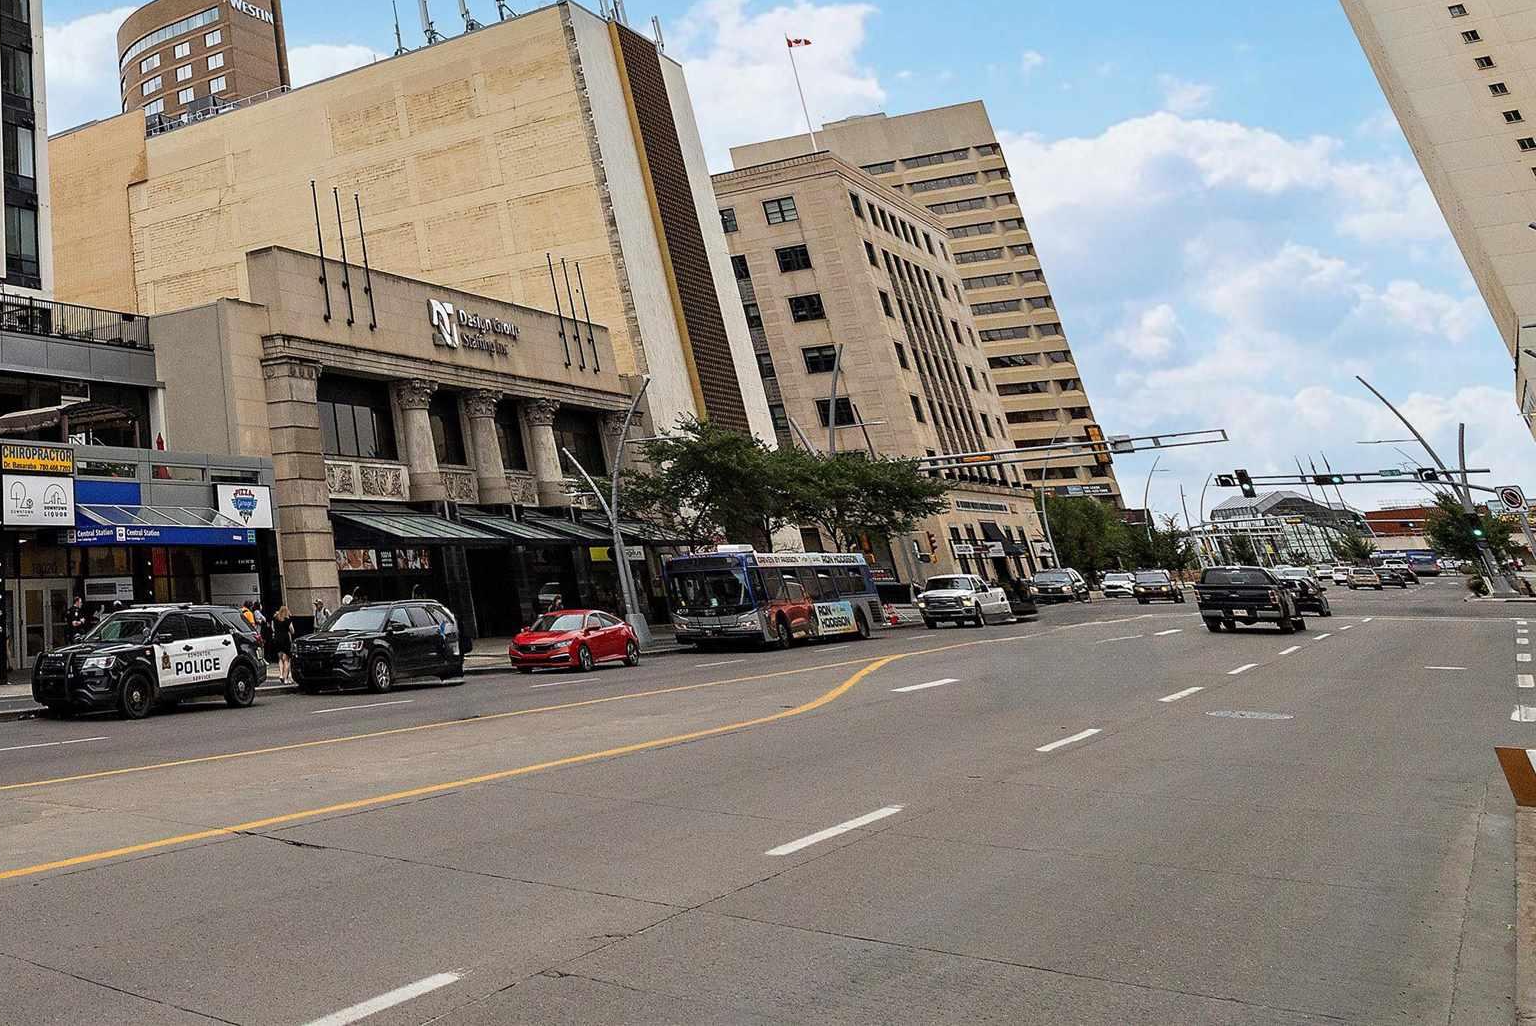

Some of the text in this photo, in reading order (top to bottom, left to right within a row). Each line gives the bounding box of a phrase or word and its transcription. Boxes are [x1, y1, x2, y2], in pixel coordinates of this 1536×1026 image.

[2, 445, 72, 462] CHIROPRACTOR
[144, 529, 160, 537] Station
[817, 606, 832, 616] RON
[820, 617, 851, 628] HODGSON
[175, 657, 221, 676] POLICE
